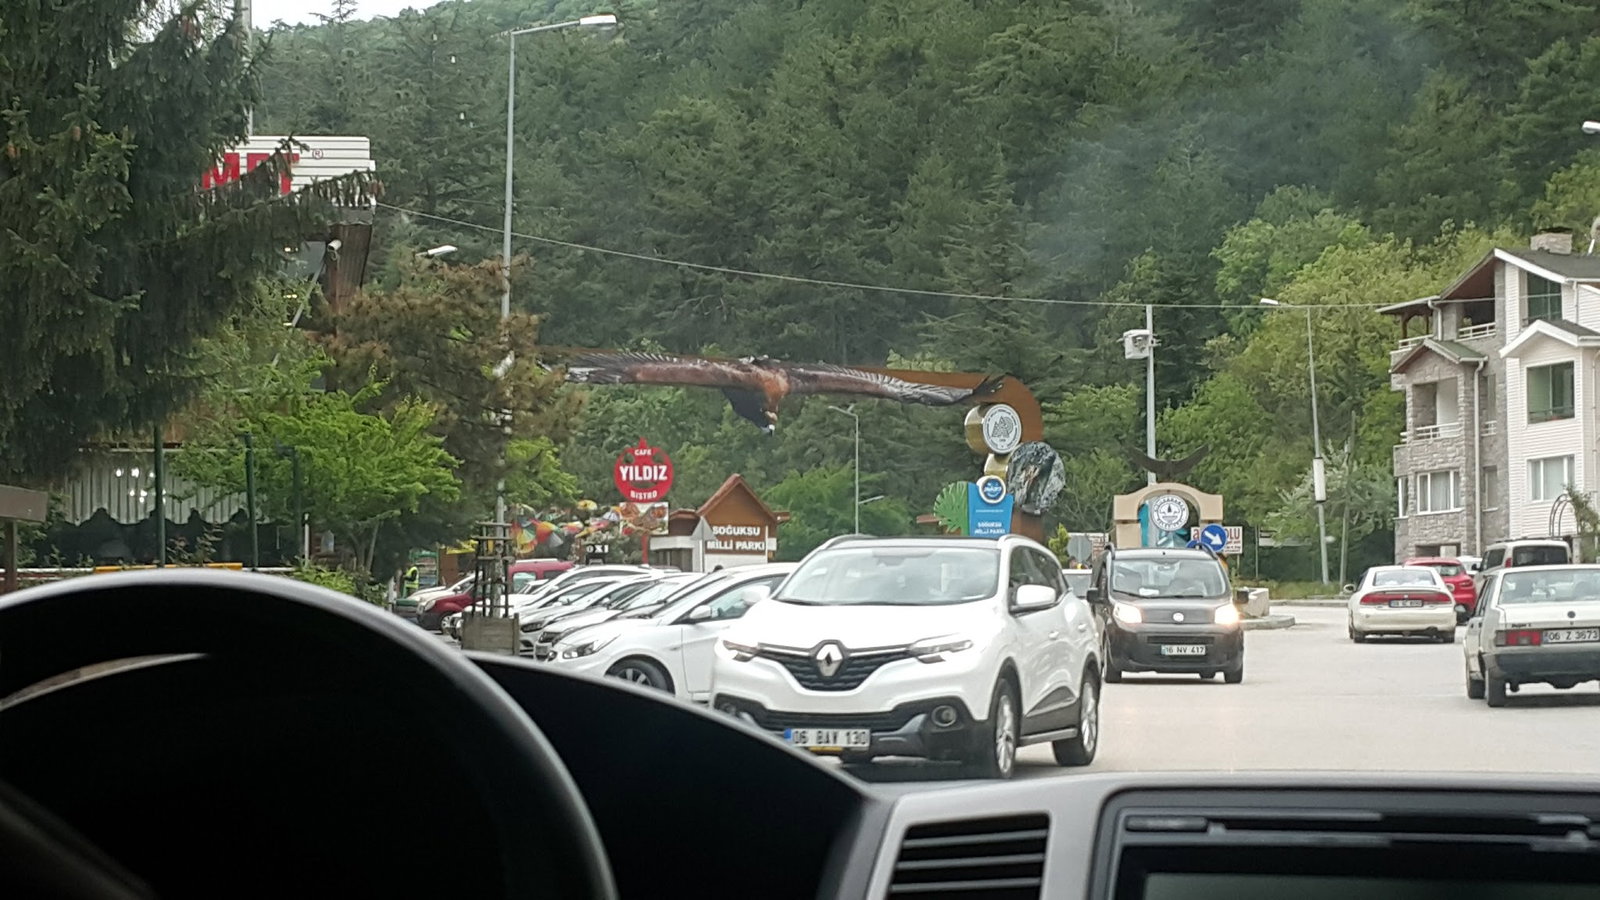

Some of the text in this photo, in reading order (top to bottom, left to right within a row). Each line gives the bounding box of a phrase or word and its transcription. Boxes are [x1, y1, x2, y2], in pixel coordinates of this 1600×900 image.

[634, 448, 652, 456] CAFE
[619, 465, 668, 481] YILDIZ
[712, 524, 761, 536] SOĞUKSU
[794, 730, 808, 744] 06
[846, 731, 867, 745] 130
